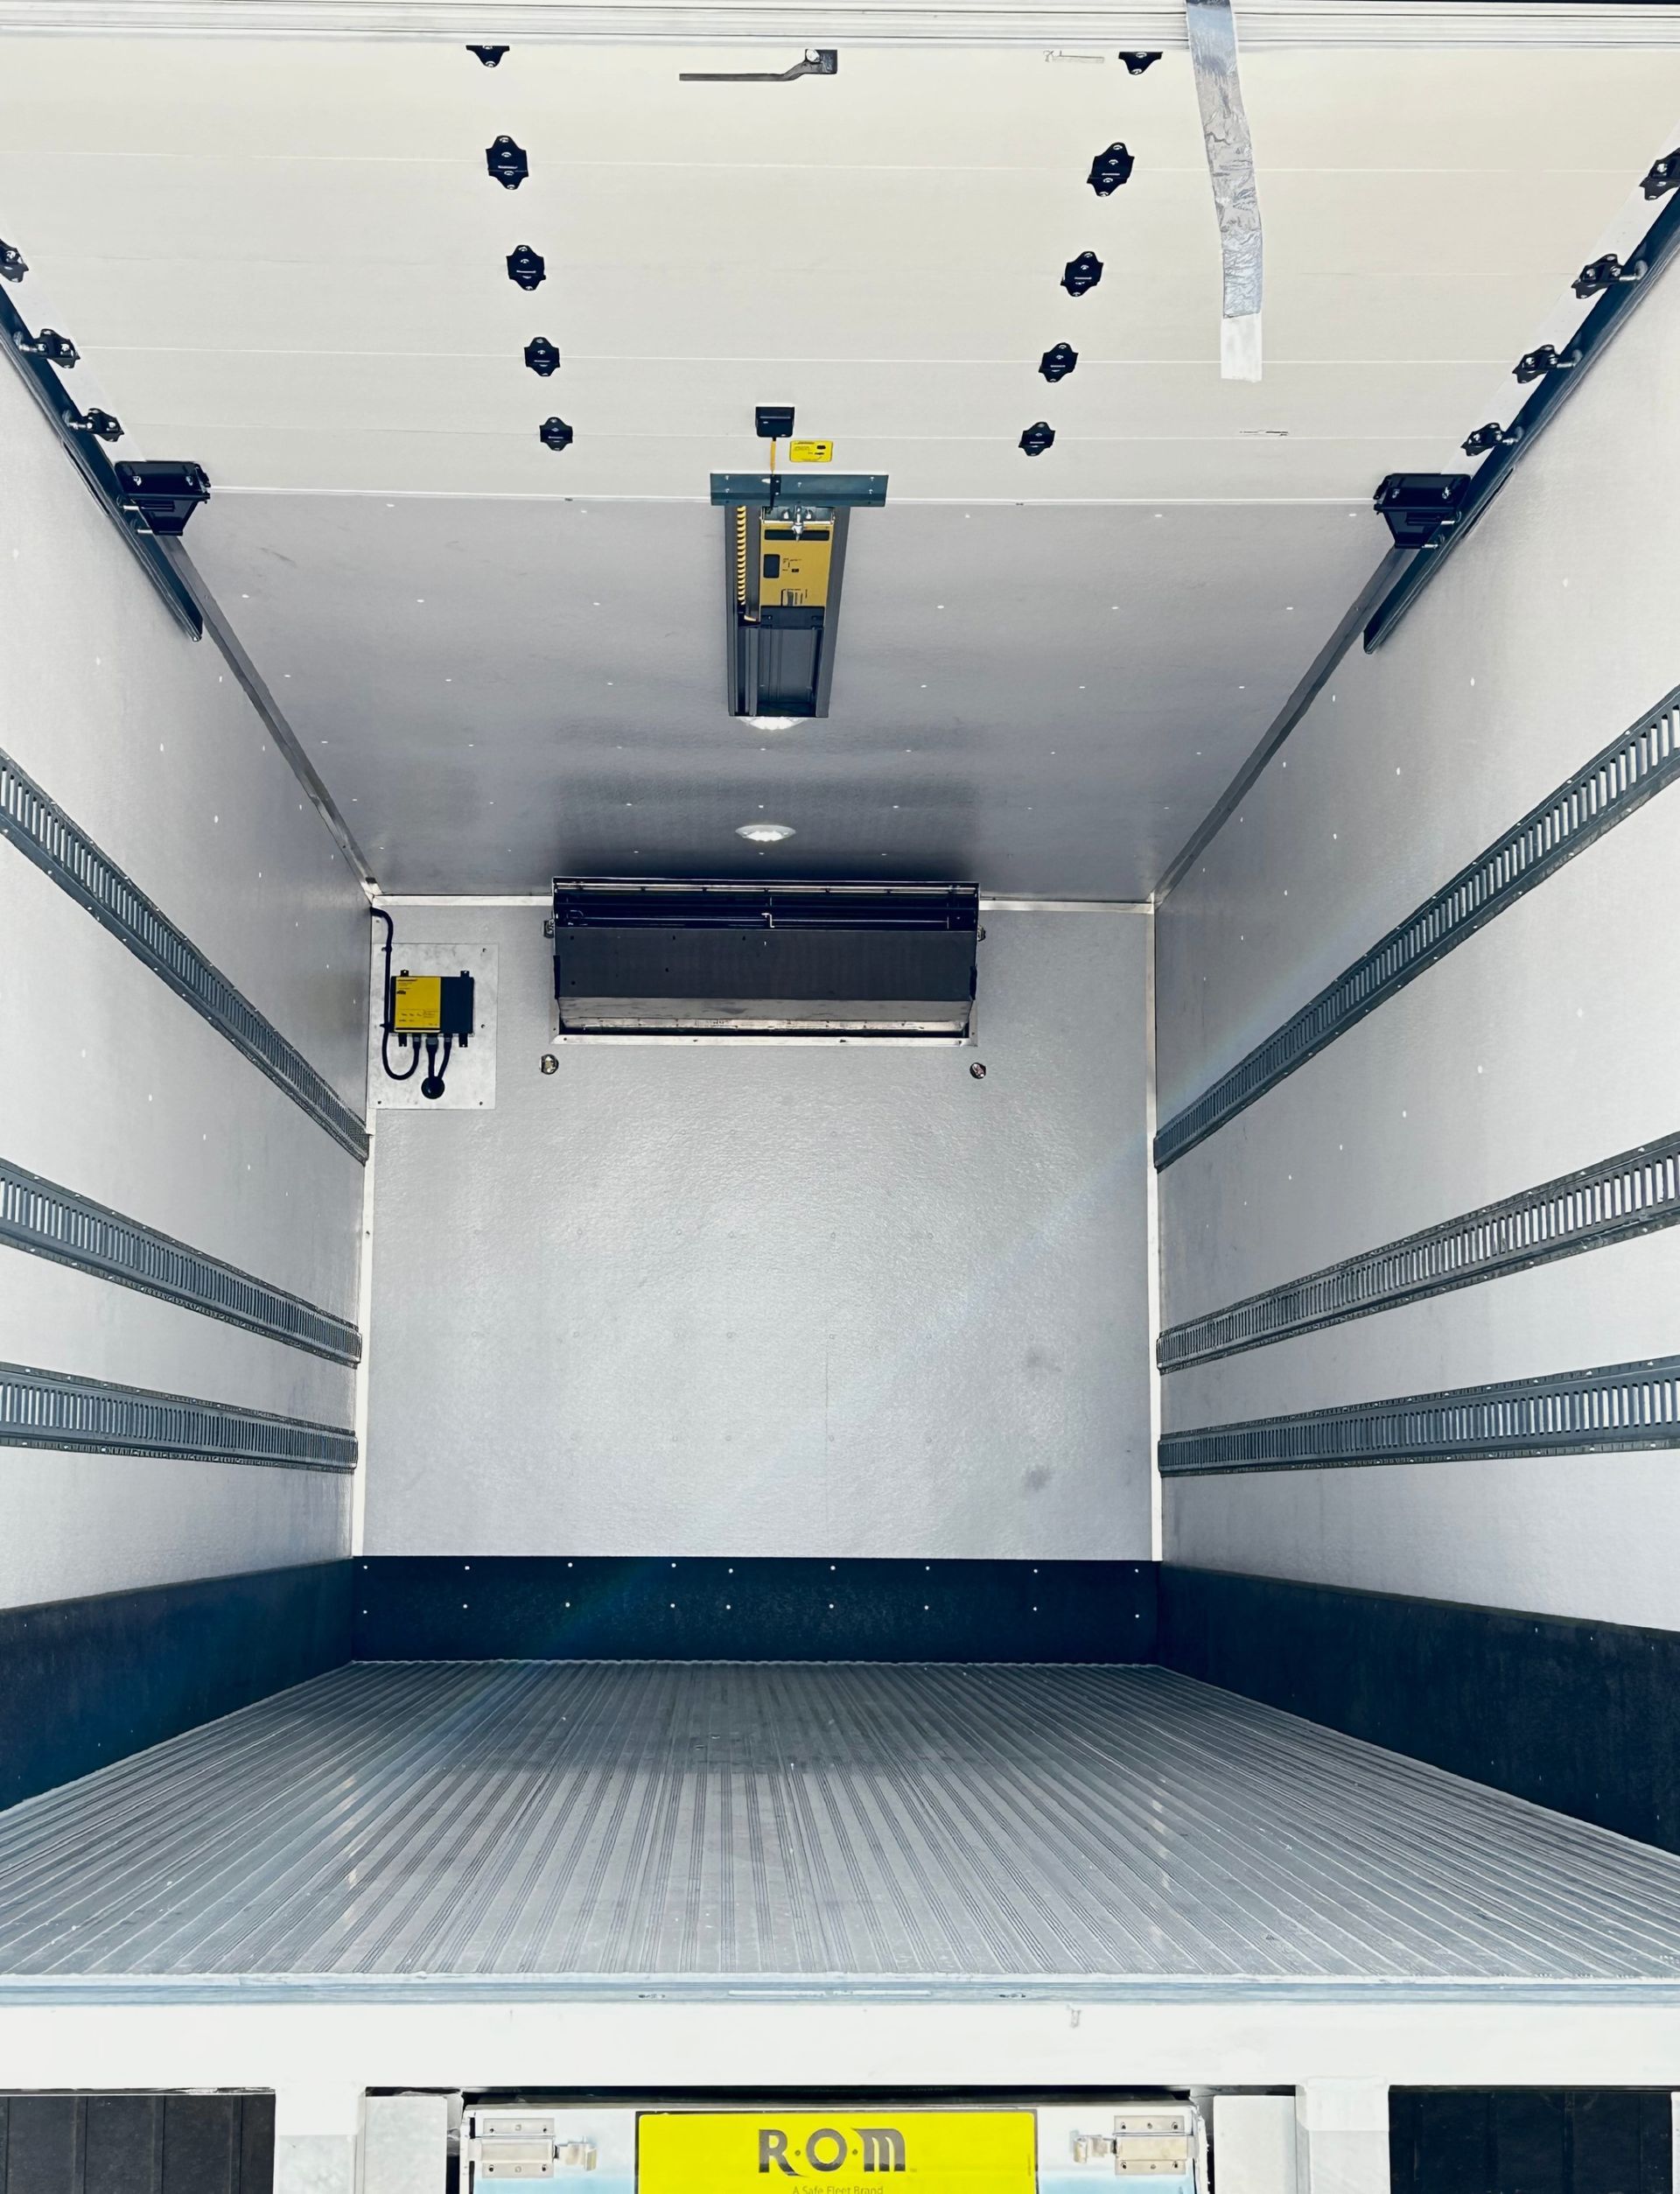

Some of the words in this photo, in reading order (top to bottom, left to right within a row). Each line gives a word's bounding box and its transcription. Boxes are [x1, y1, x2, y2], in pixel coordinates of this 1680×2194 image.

[793, 2185, 800, 2194] A
[802, 2185, 823, 2194] Safe
[827, 2185, 850, 2194] Fleet
[854, 2185, 883, 2194] Brand
